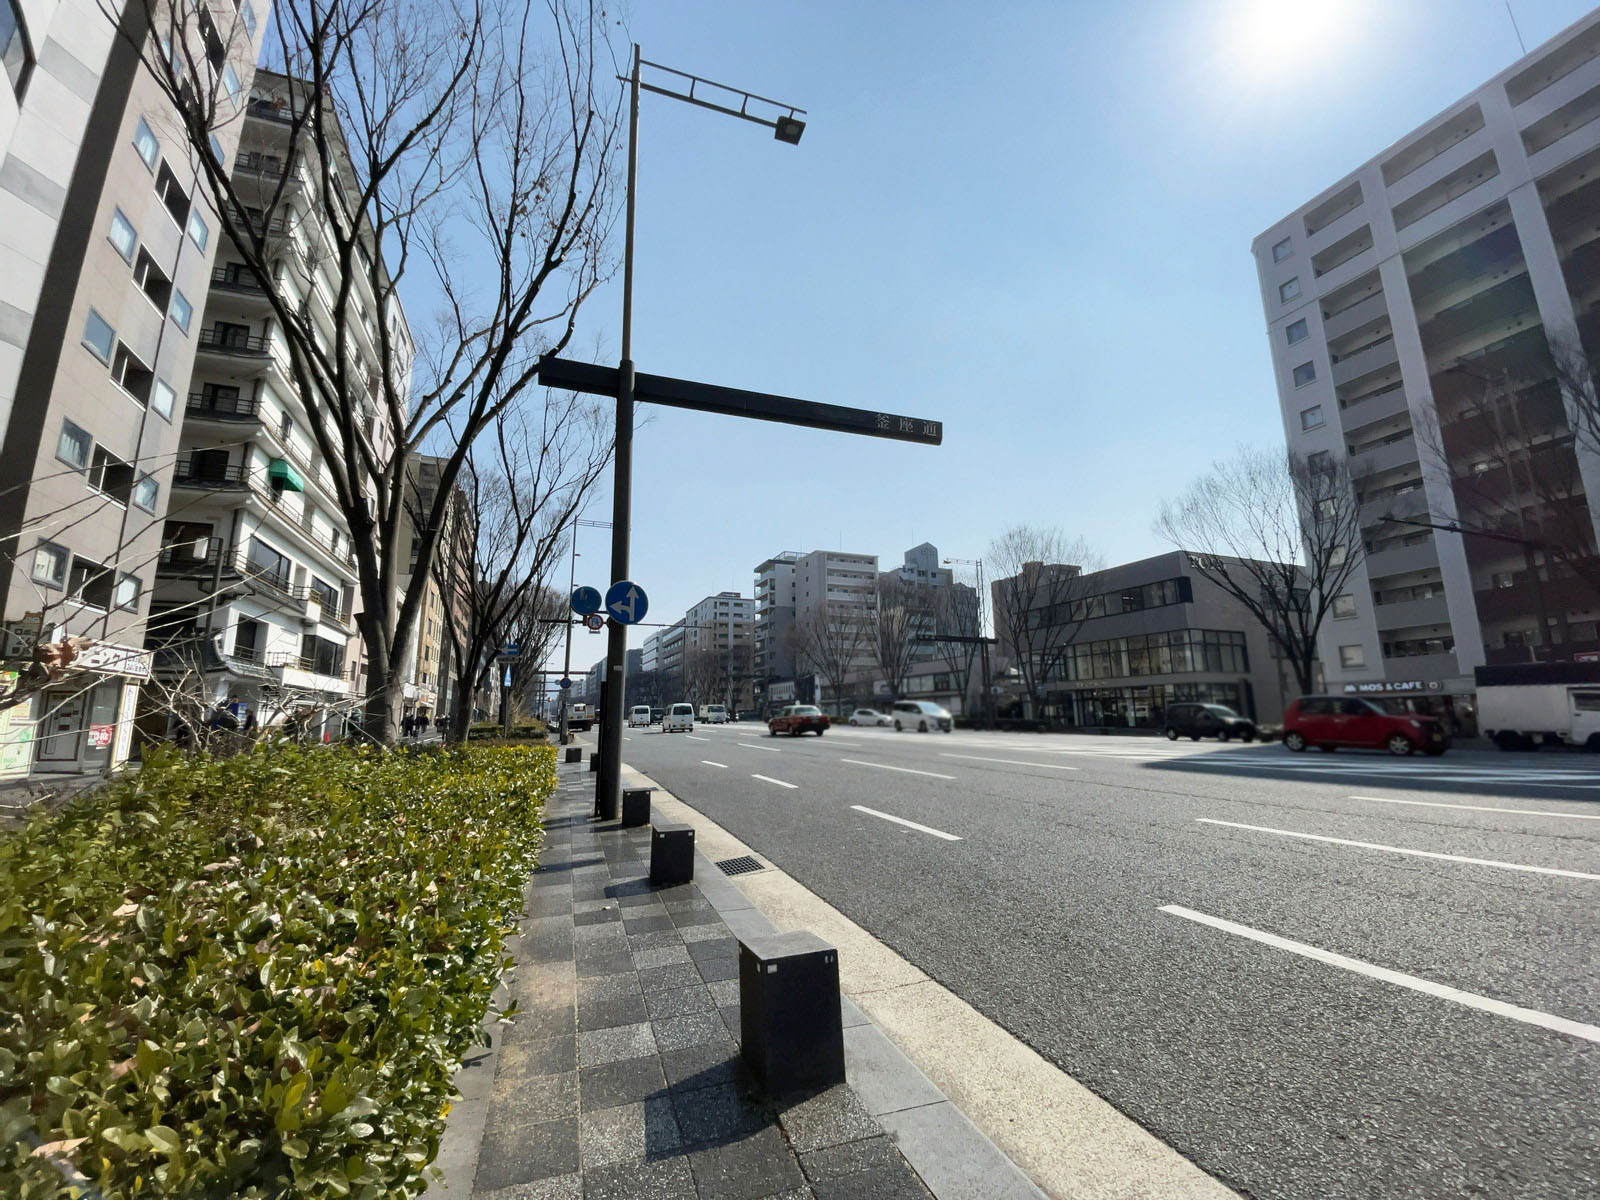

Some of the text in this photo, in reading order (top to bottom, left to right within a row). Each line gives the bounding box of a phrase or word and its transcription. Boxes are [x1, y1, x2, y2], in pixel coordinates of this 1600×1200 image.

[875, 413, 937, 436] 釜座通
[1359, 683, 1383, 692] MOS
[1394, 681, 1422, 690] CAFE
